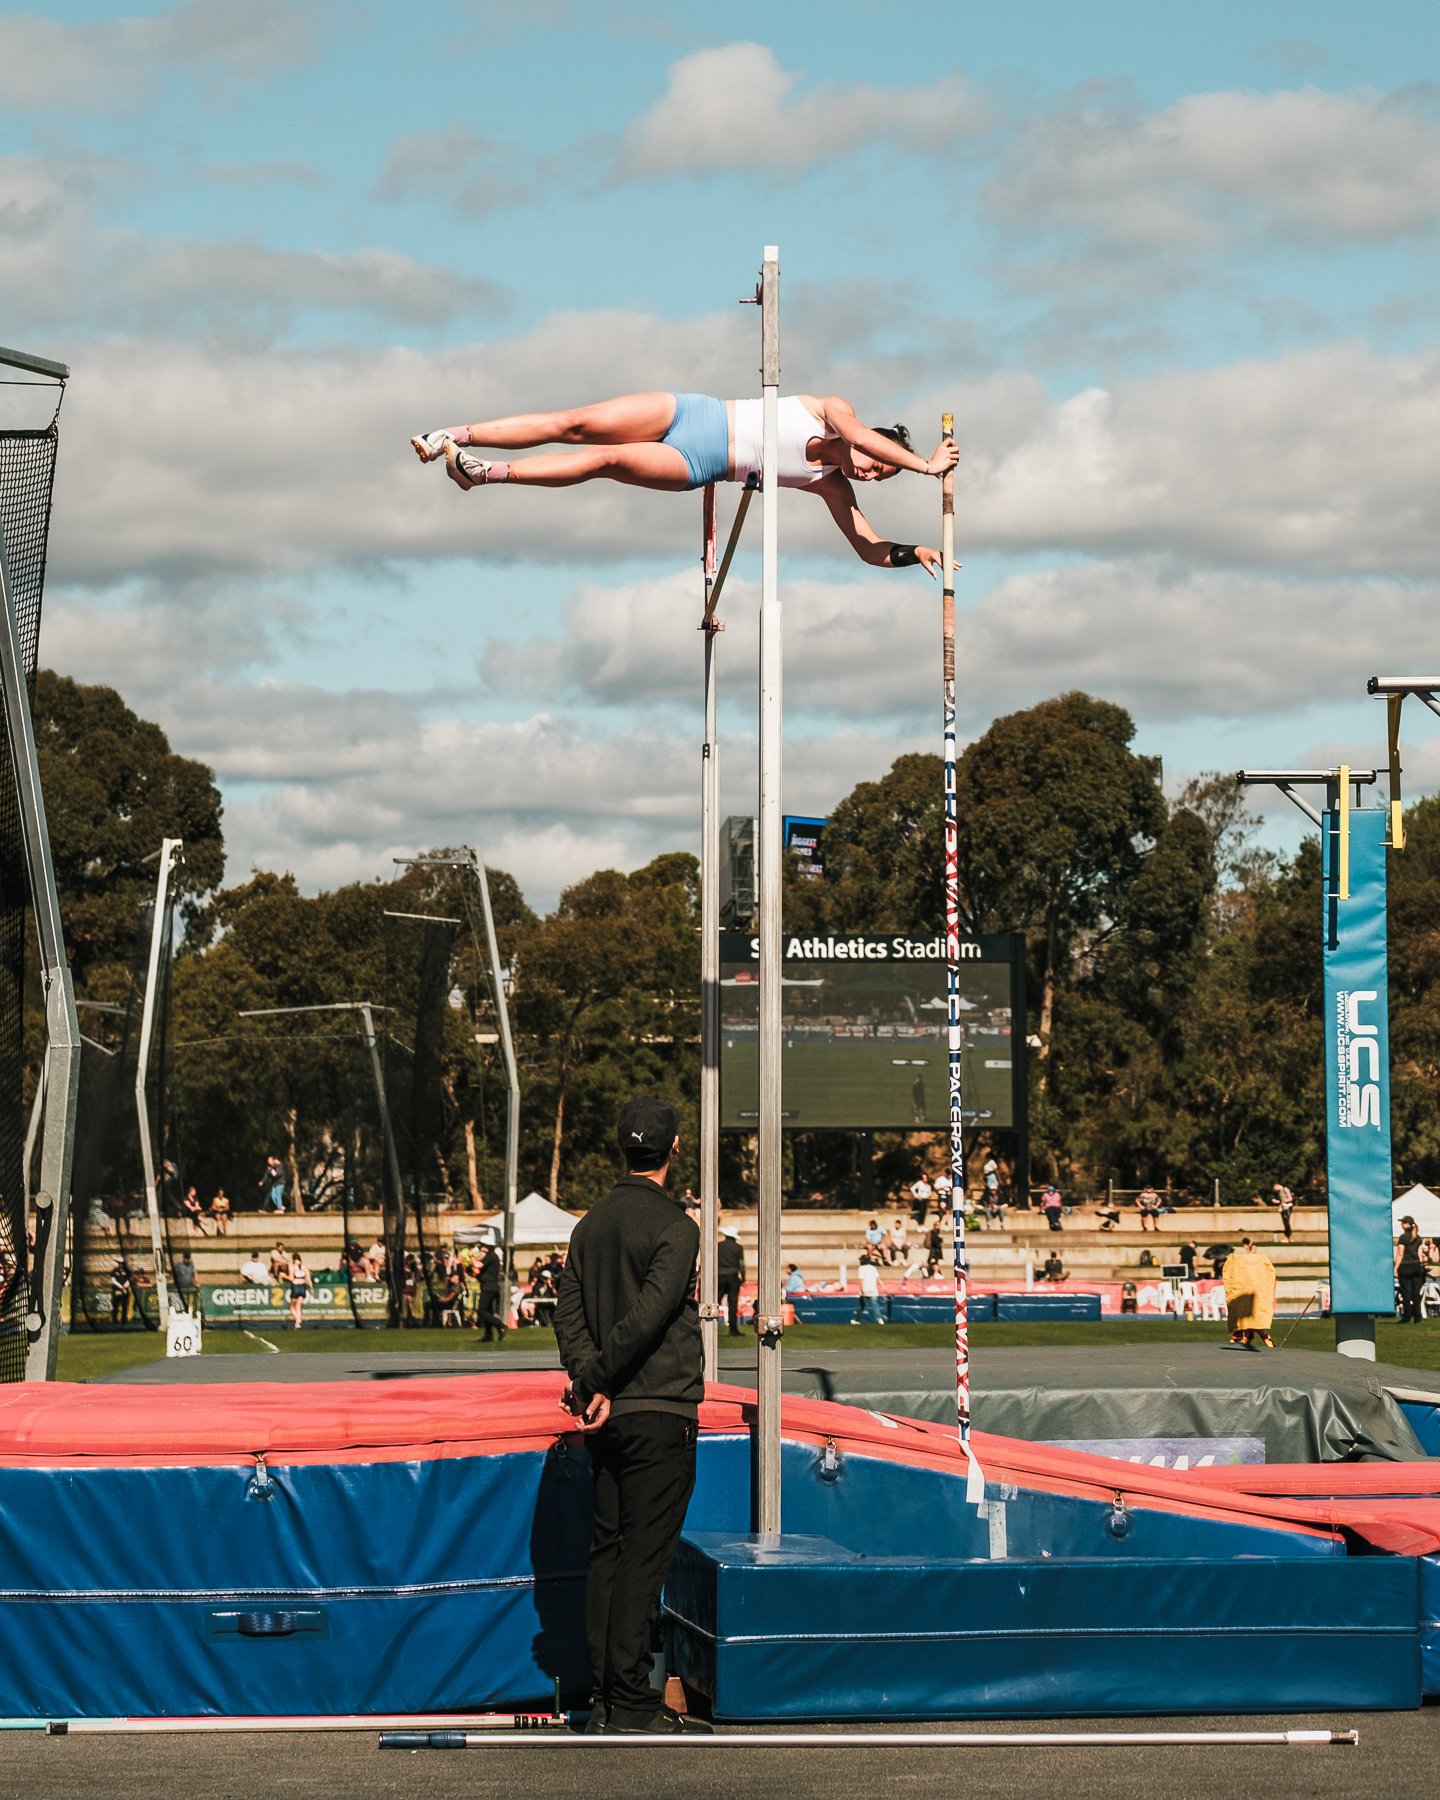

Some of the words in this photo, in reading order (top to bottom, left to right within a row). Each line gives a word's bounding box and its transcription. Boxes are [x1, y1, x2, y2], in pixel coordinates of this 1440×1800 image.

[786, 937, 887, 959] Athletics
[892, 937, 982, 959] Stadim
[1336, 990, 1347, 1128] WWW.UCSSPIRIT.COM
[1349, 990, 1380, 1128] UCS
[212, 1288, 269, 1305] GREEN
[173, 1336, 192, 1352] 60
